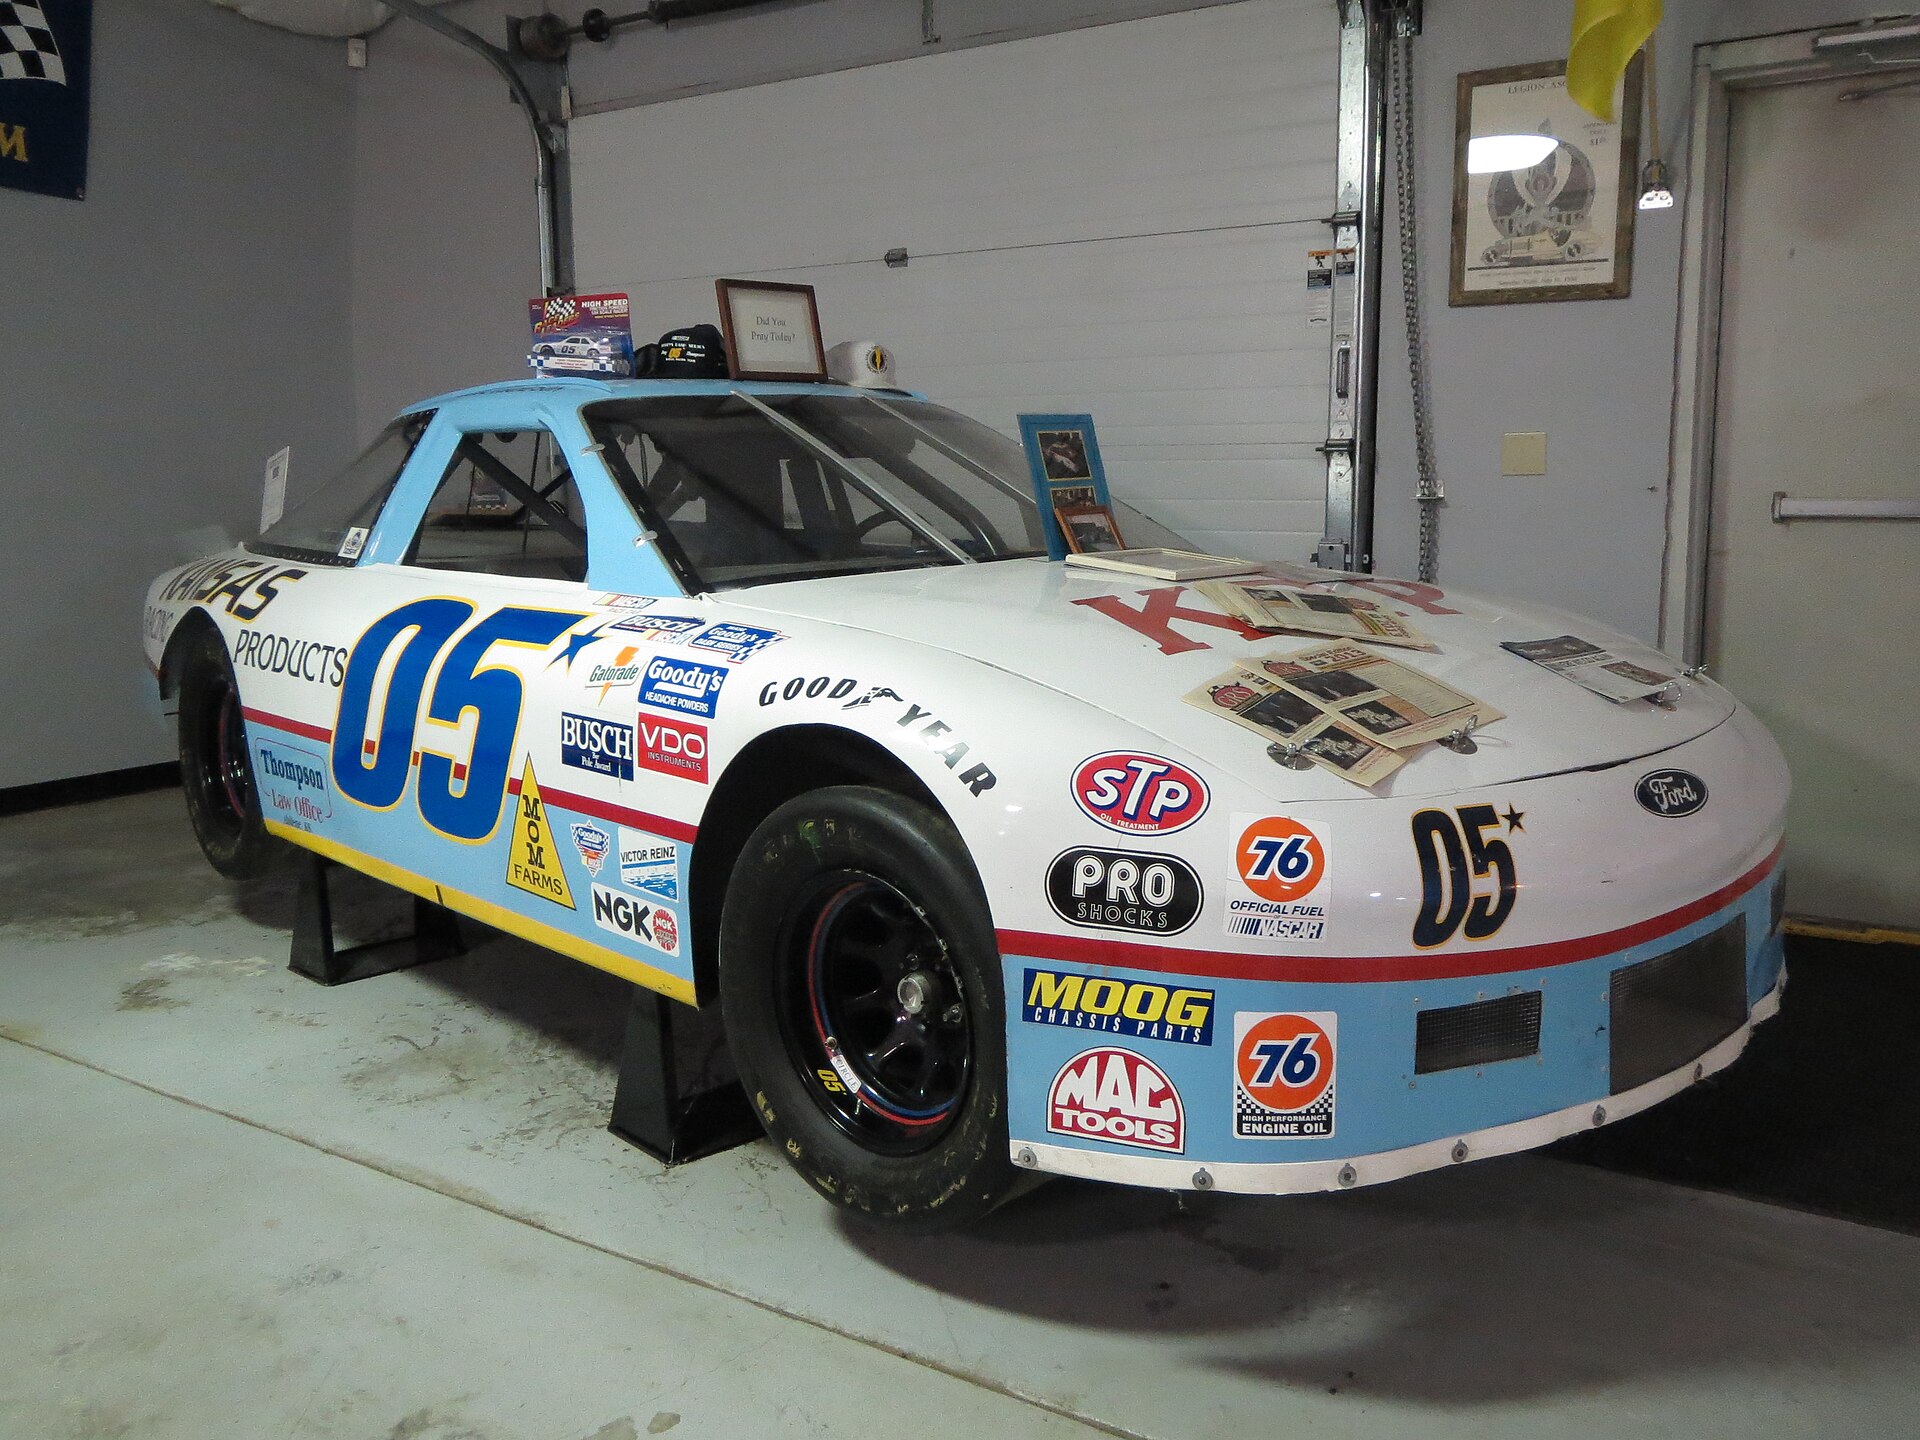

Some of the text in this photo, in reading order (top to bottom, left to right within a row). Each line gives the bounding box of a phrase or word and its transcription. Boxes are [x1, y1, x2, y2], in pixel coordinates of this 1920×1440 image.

[751, 331, 796, 344] Pray Today?
[756, 316, 786, 327] Did You
[561, 345, 576, 353] 05
[159, 558, 308, 622] KANSAS
[613, 595, 656, 608] NASCAR
[625, 615, 697, 633] BUSCH
[649, 631, 693, 645] NASCAR
[707, 628, 759, 642] Goody's
[233, 629, 348, 687] PRODUCTS
[1331, 649, 1367, 662] 2013
[588, 664, 639, 683] Gatorade
[648, 659, 724, 694] Goody's
[645, 691, 709, 714] HEADACHE POWDERS
[330, 595, 594, 846] 05
[758, 676, 998, 797] GOOD YEAR
[562, 716, 632, 760] BUSCH
[640, 722, 706, 759] VDO
[260, 749, 324, 790] Thompson
[581, 756, 612, 772] Pole Award
[647, 751, 702, 772] INSTRUMENTS
[1085, 759, 1191, 819] STP
[1650, 777, 1698, 813] Ford
[271, 788, 292, 809] Law
[294, 796, 323, 823] Office
[522, 794, 545, 869] MOM
[1100, 813, 1160, 831] OIL TREATMENT
[620, 846, 676, 863] VICTOR REINZ
[1245, 833, 1314, 884] 76
[514, 864, 563, 896] FARMS
[1072, 854, 1175, 908] PRO
[1411, 803, 1518, 950] 05
[593, 889, 653, 942] NGK
[655, 917, 673, 932] NGK
[1077, 902, 1168, 929] SHOCKS
[1230, 900, 1325, 917] OFFICIAL FUEL
[1258, 919, 1322, 939] NASCAR
[1027, 972, 1213, 1028] MOOG
[1034, 1006, 1202, 1043] CHASSIS PARTS
[1248, 1032, 1320, 1088] 76
[816, 1069, 846, 1092] 05
[1055, 1054, 1177, 1122] MAC
[1055, 1107, 1177, 1144] TOOLS
[1242, 1114, 1328, 1122] HIGH PERFORMANCE
[1242, 1122, 1327, 1135] ENGINE OIL
